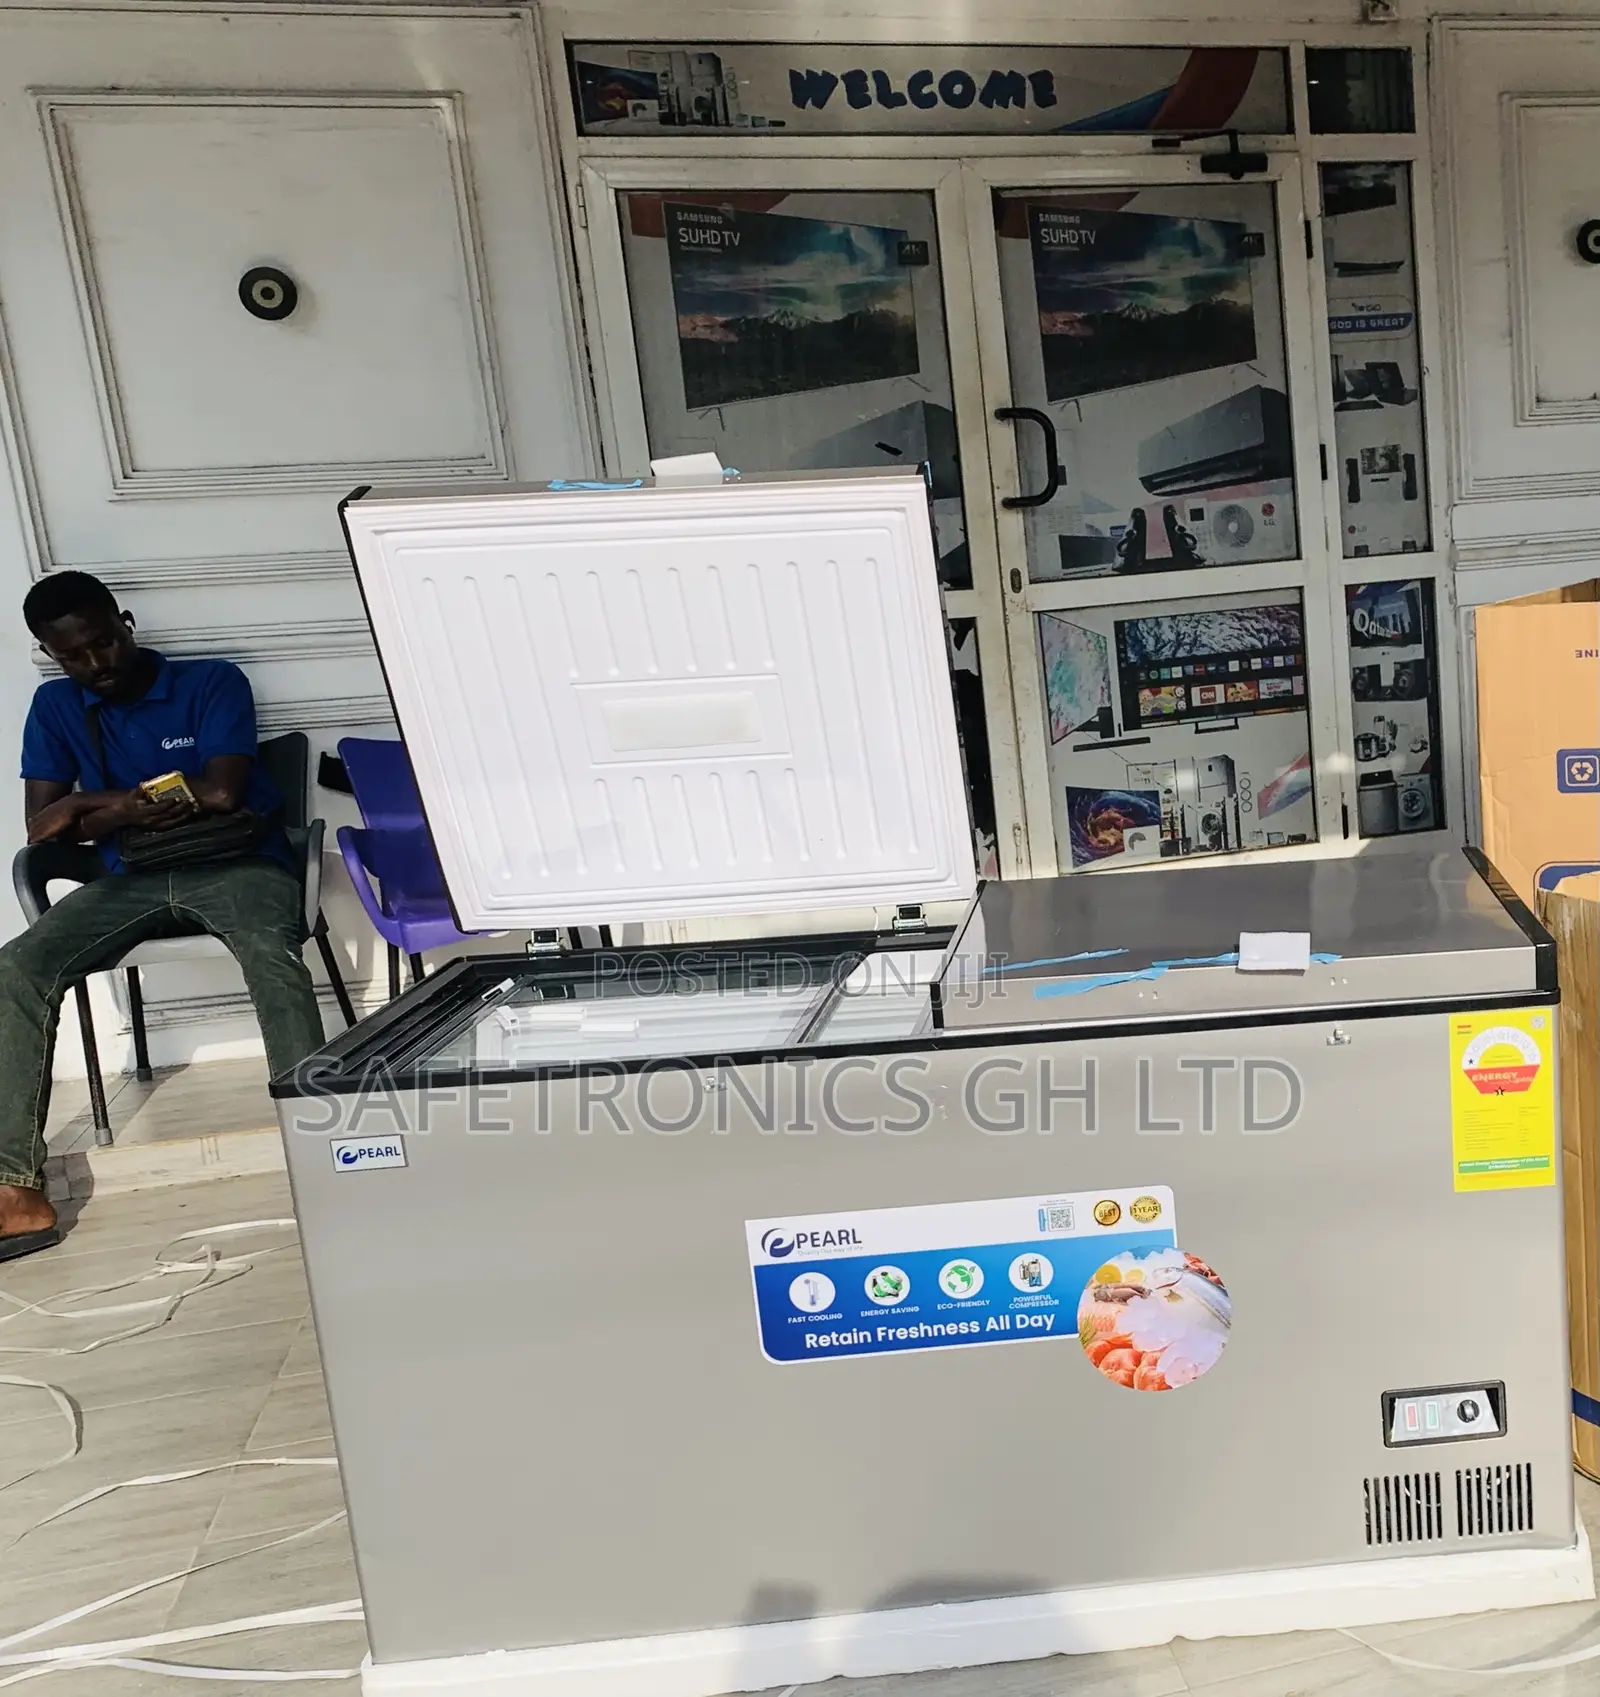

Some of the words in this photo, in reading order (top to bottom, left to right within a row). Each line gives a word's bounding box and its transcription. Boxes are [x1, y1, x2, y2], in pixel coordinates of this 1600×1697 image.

[789, 69, 1057, 109] WELCOME
[676, 212, 723, 224] SAMSUNG
[1039, 213, 1080, 224] SAMSUNG
[1329, 321, 1352, 329] GOD
[1356, 319, 1366, 328] IS
[1370, 318, 1405, 328] GREAT
[358, 1145, 401, 1159] PEARL
[1099, 1208, 1116, 1218] BEST
[1138, 1205, 1159, 1214] YEAR
[796, 1228, 862, 1249] PEARL
[1013, 1293, 1052, 1303] POWERFUL
[937, 1299, 990, 1310] ECO-FRIENDLY
[1009, 1299, 1060, 1309] COMPRESSOR
[860, 1308, 889, 1317] ENERGY
[891, 1305, 920, 1315] SAVING
[788, 1315, 806, 1324] FAST
[808, 1313, 843, 1322] COOLING
[805, 1328, 872, 1349] Retain
[876, 1320, 980, 1342] Freshness
[985, 1313, 1011, 1332] All
[1015, 1313, 1056, 1331] Day
